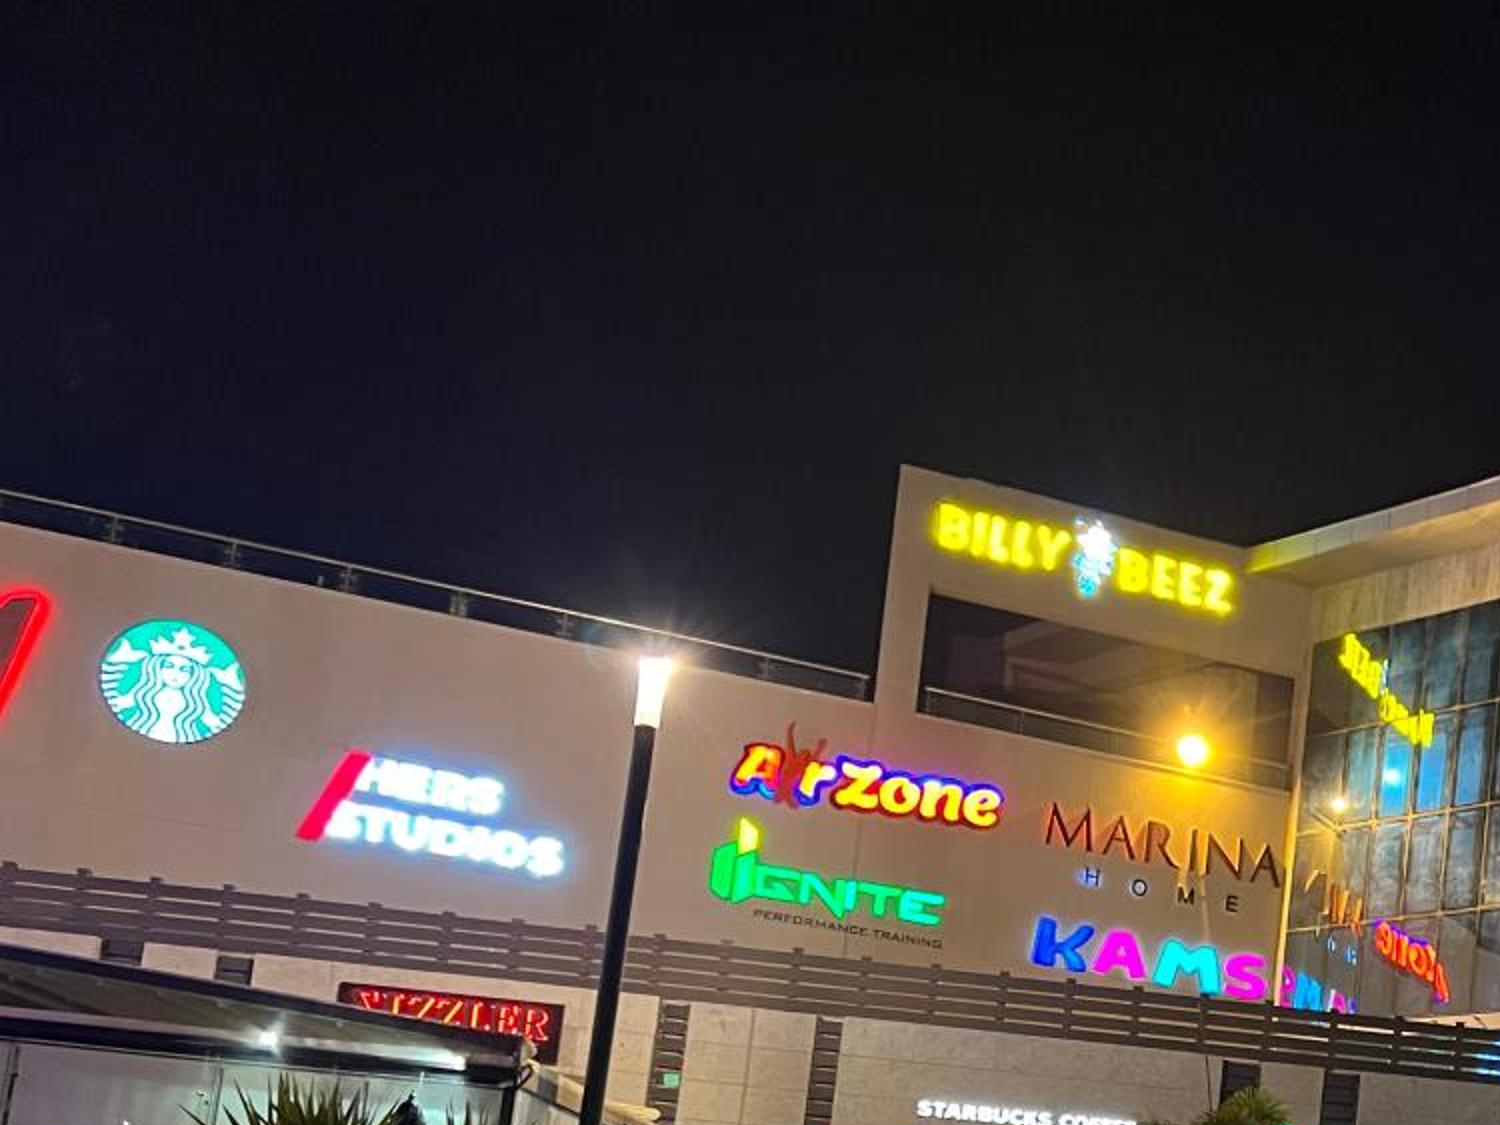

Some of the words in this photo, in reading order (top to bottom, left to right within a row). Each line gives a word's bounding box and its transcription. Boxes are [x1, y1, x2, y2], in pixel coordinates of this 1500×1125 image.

[937, 502, 1073, 571] BILLY
[1116, 546, 1232, 617] BEEZ
[354, 757, 505, 816] HERS
[323, 799, 564, 877] STUDIOS
[1045, 801, 1280, 888] MARINA
[753, 908, 869, 937] PERFORMANCE
[873, 928, 943, 949] TRAINING
[1085, 867, 1239, 913] HOME
[1031, 915, 1269, 1001] KAMS
